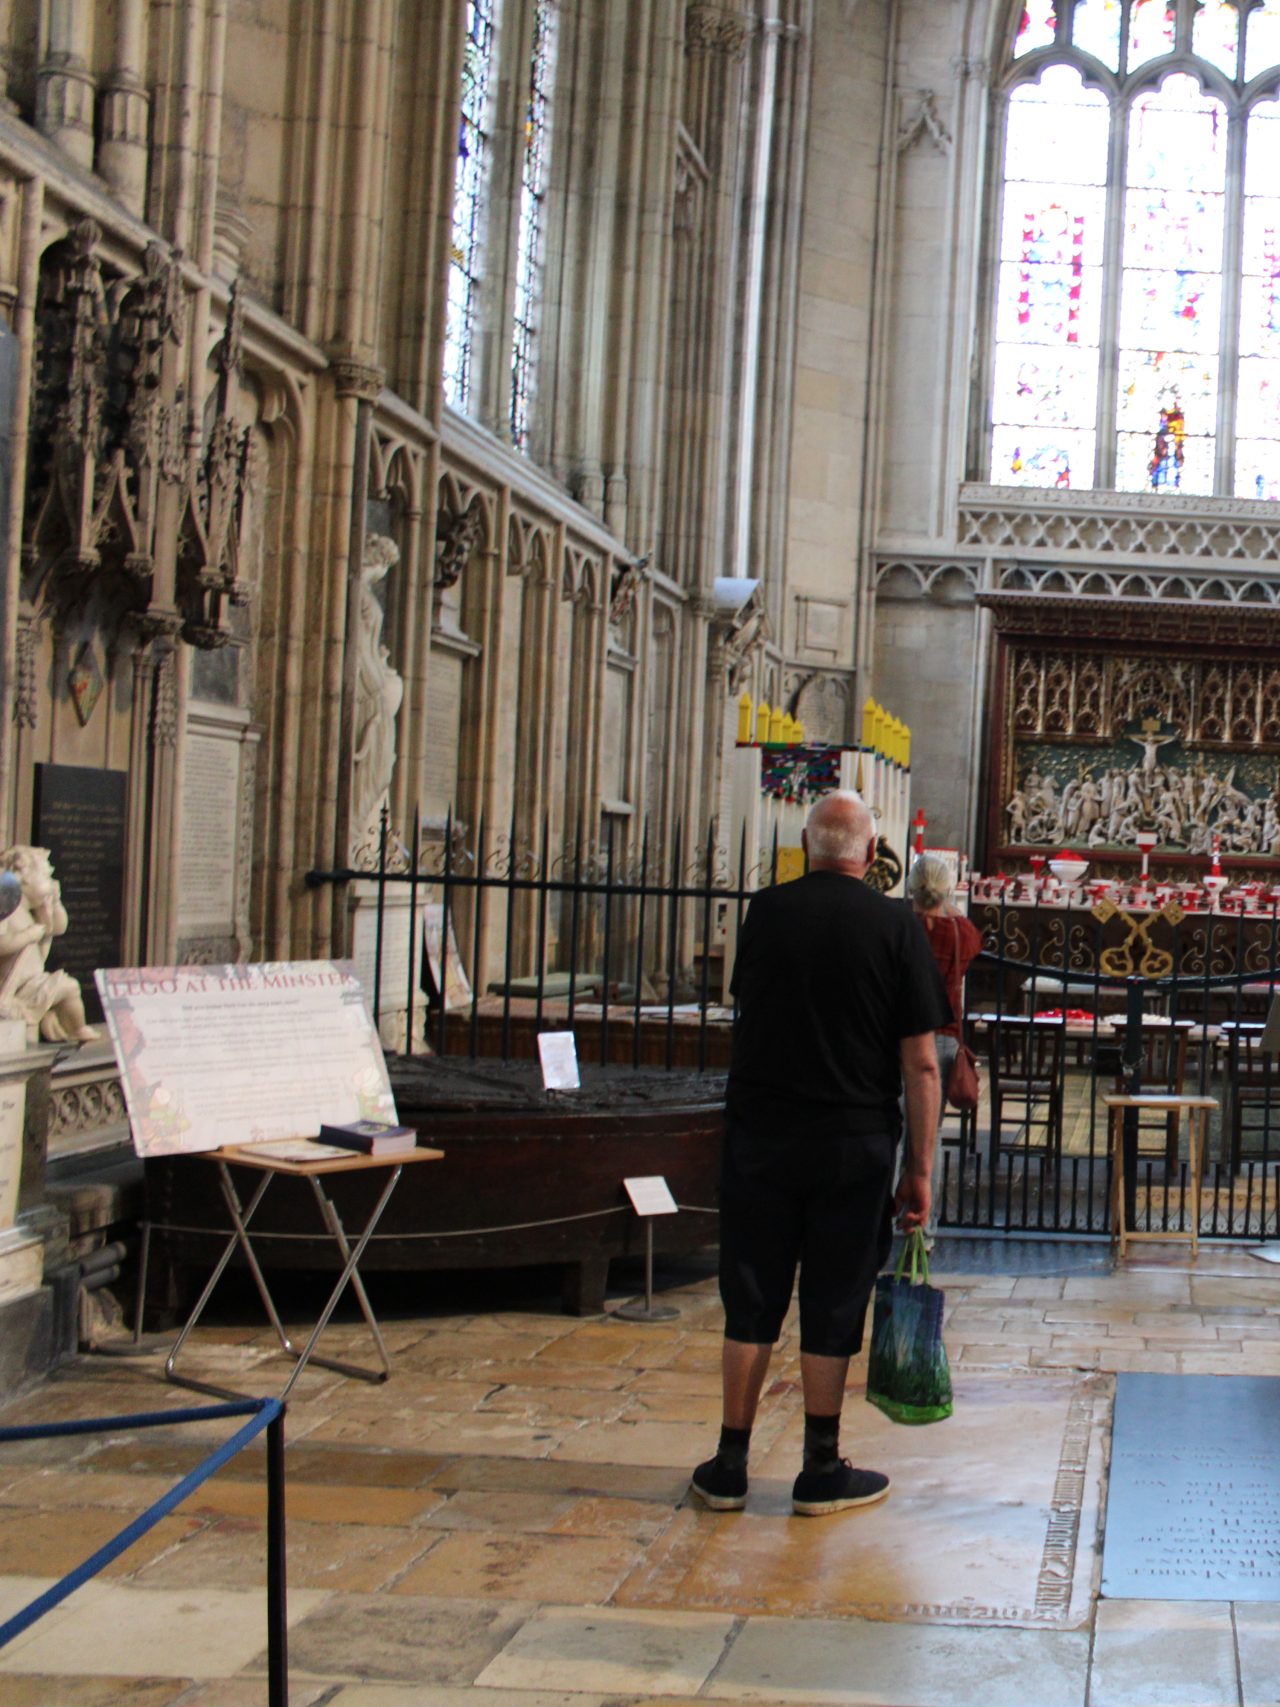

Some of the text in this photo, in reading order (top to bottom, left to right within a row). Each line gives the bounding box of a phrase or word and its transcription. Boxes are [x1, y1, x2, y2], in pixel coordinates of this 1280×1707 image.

[110, 972, 355, 998] LEGO AT THE MINSTER
[1125, 1568, 1229, 1580] MARBLE
